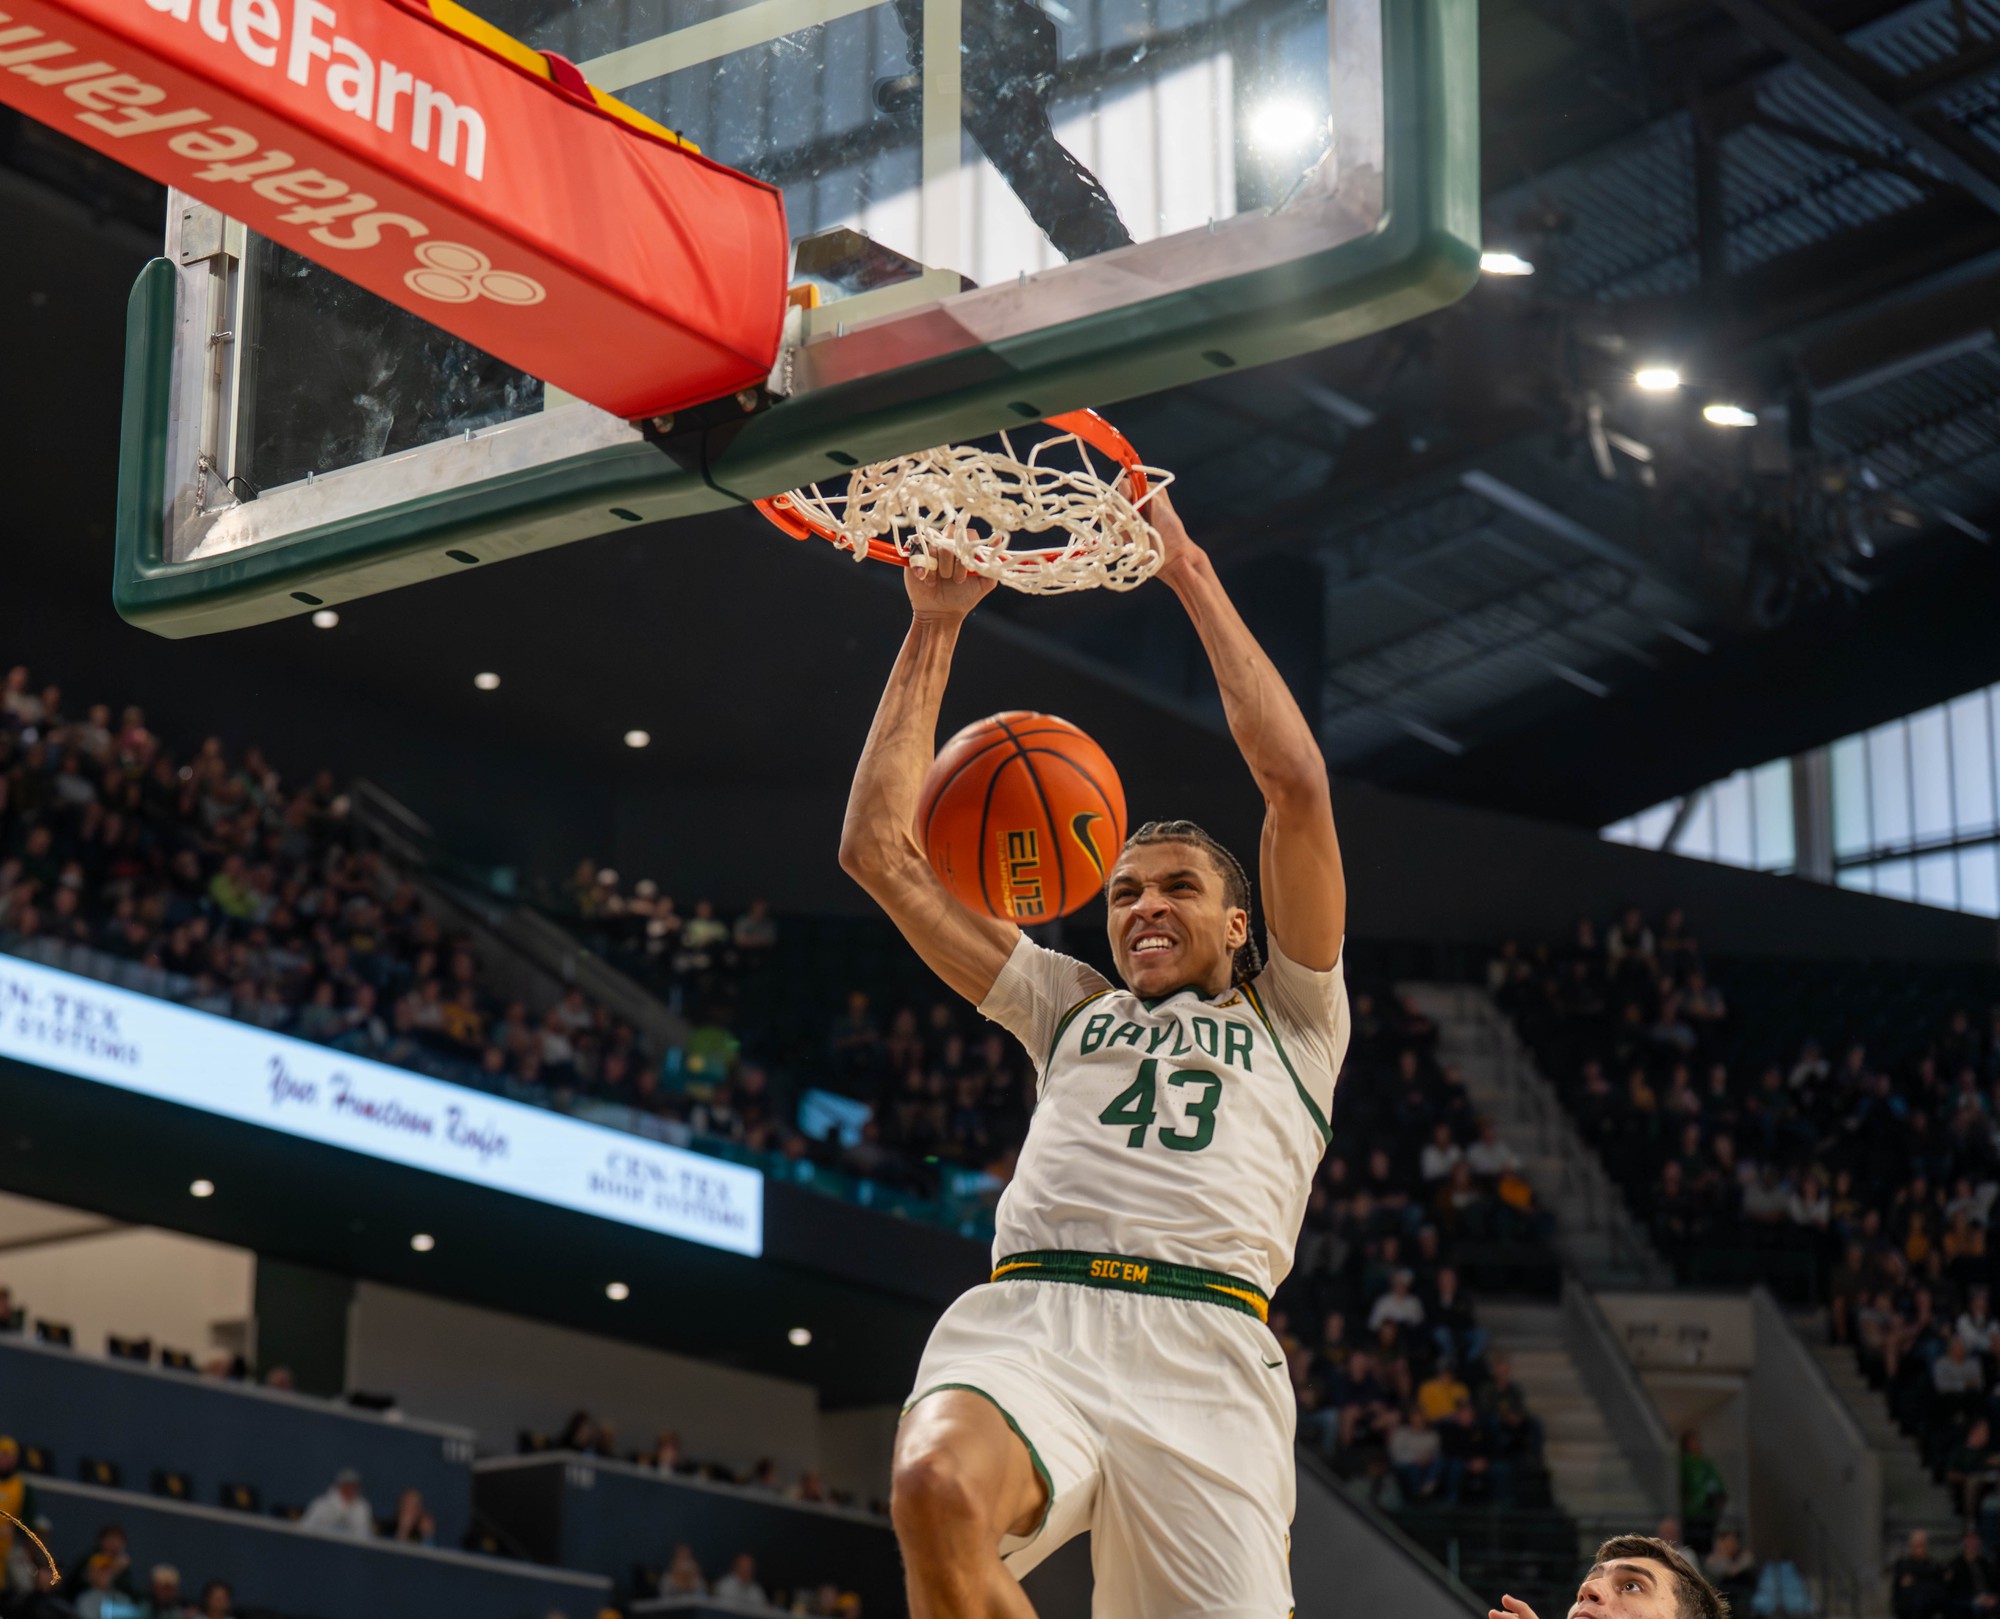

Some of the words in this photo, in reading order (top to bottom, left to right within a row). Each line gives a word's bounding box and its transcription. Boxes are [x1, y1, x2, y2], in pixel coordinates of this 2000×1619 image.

[1006, 828, 1047, 918] ELITE
[0, 976, 121, 1036] N-TEX
[1080, 1013, 1254, 1073] BAYLOR
[1098, 1058, 1223, 1152] 43
